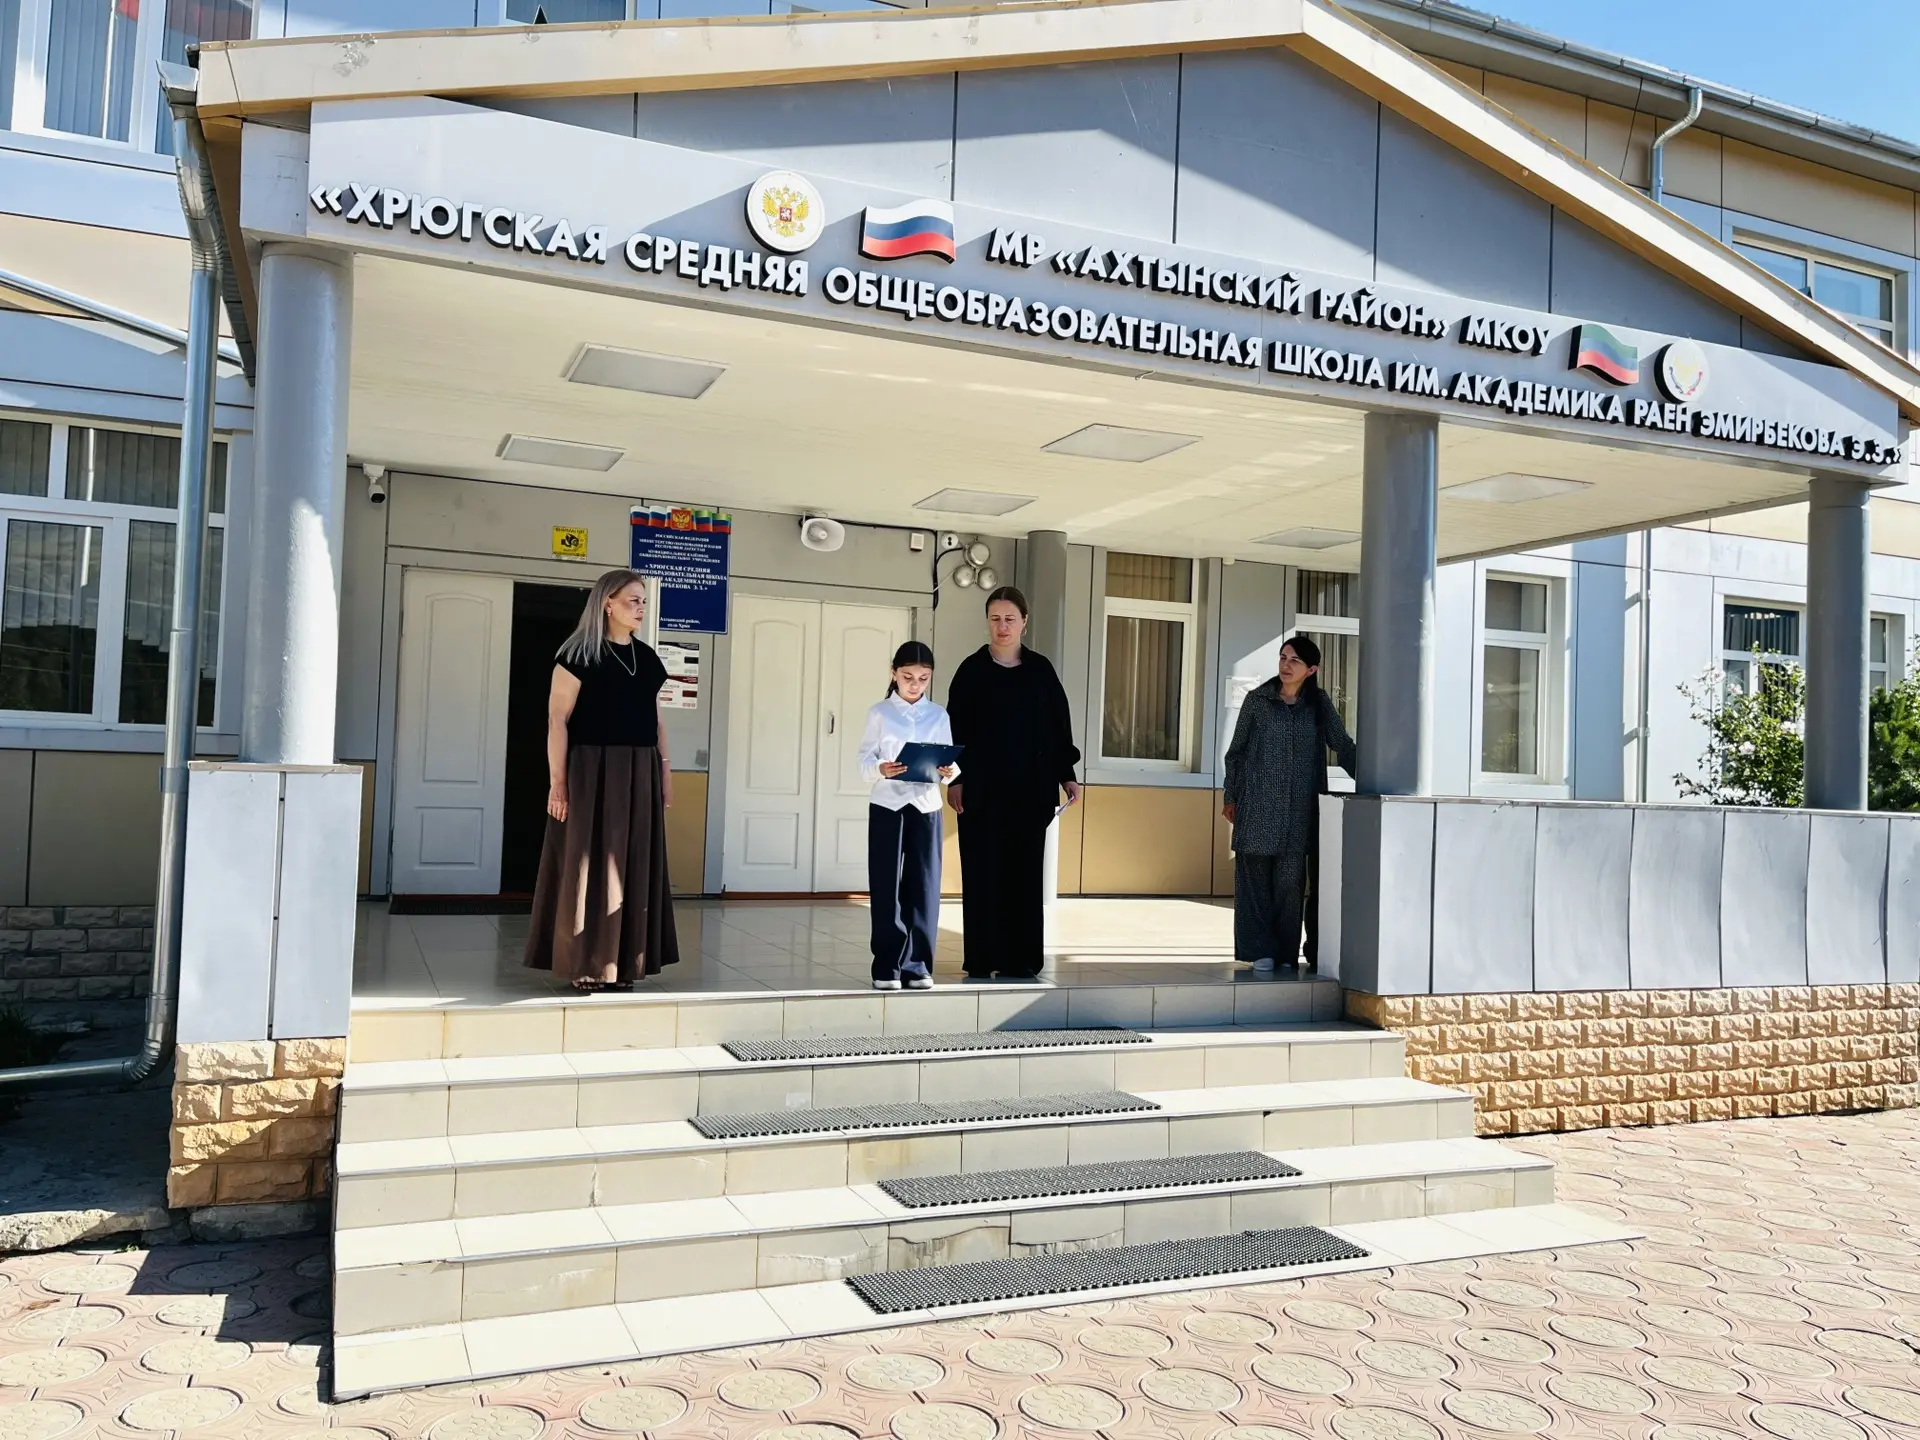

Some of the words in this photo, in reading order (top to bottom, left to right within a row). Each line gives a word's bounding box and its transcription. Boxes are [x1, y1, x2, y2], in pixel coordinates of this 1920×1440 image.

[309, 182, 609, 263] «ХРЮГСКАЯ
[624, 232, 810, 296] СРЕДНЯЯ
[824, 266, 1263, 368] ОБЩЕОБРАЗОВАТЕЛЬНАЯ
[1269, 341, 1386, 389] ШКОЛА
[1390, 361, 1449, 398] ИМ.
[1451, 371, 1625, 424] АКАДЕМИКА
[1628, 397, 1692, 432] РАЕН
[1695, 409, 1847, 457] ЭМИРБЕКОВА
[989, 227, 1046, 267] МР
[1052, 245, 1306, 314] «АХТЫНСКИЙ
[1315, 286, 1451, 338] РАЙОН»
[1461, 315, 1556, 356] МКОУ
